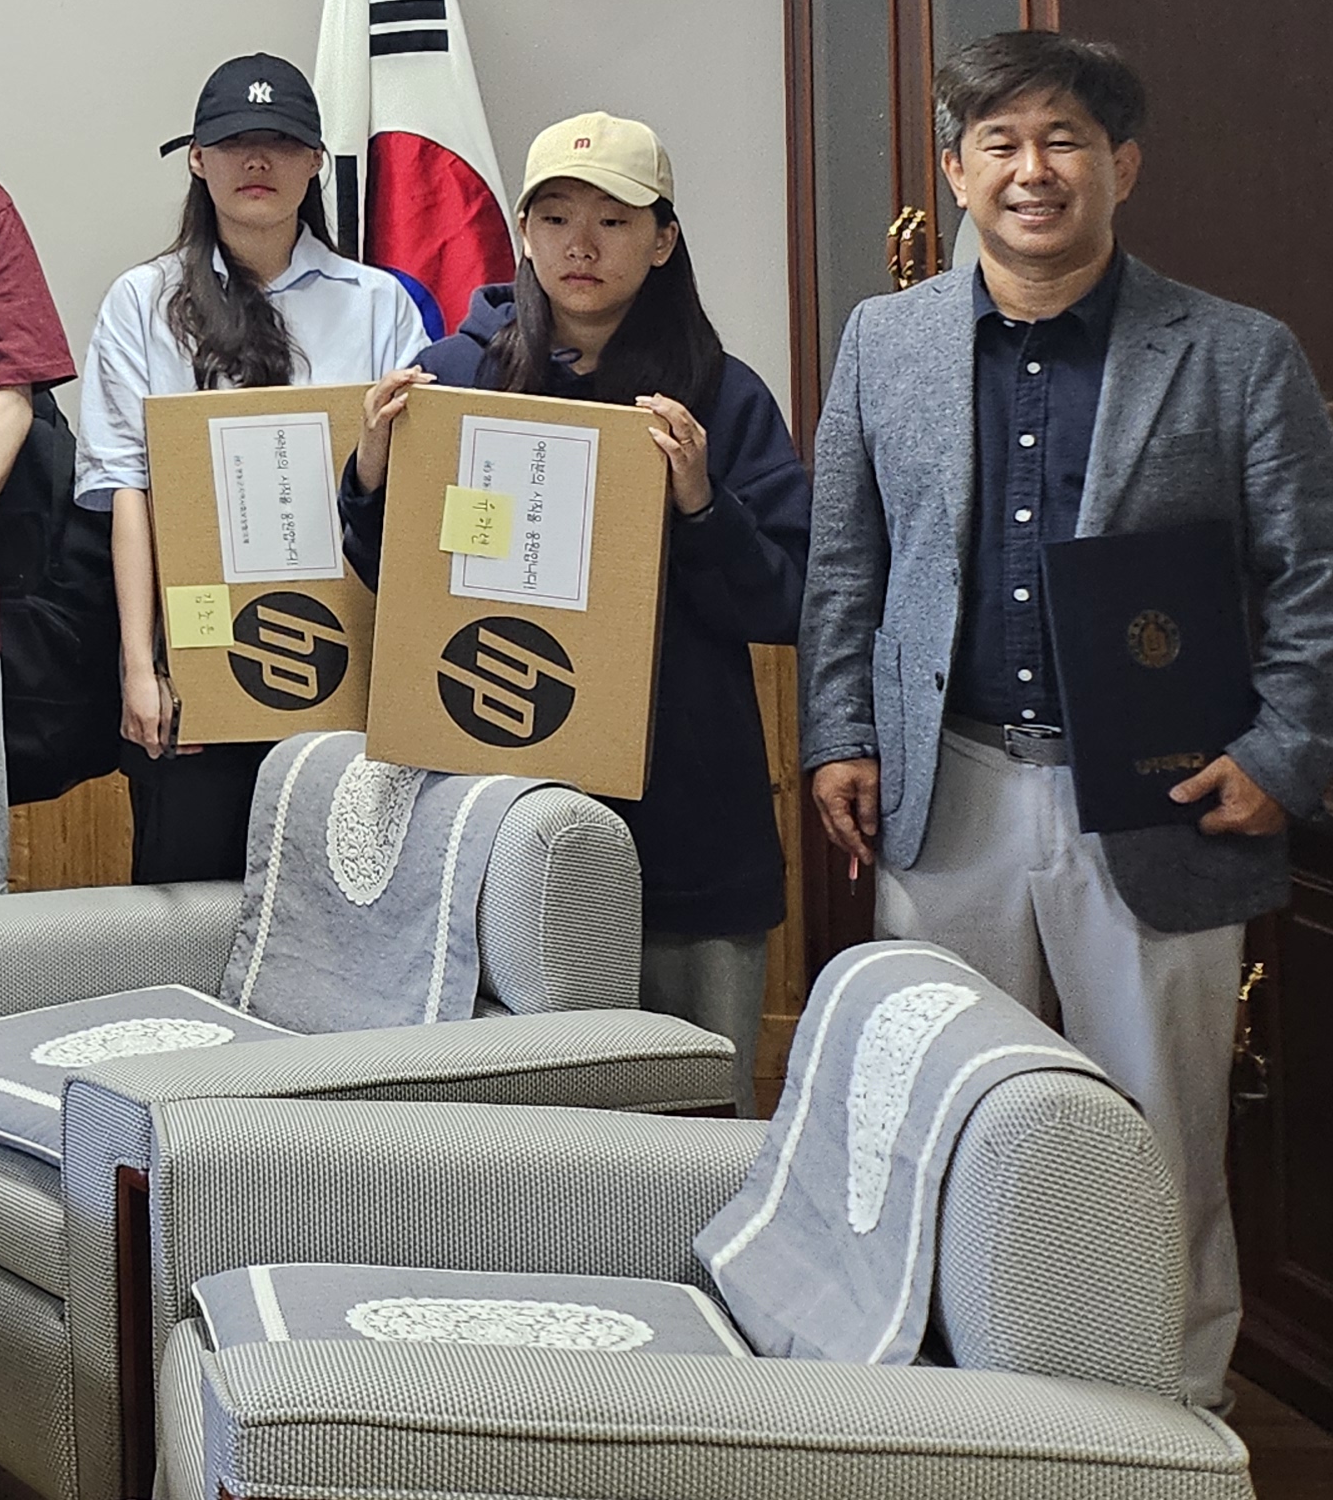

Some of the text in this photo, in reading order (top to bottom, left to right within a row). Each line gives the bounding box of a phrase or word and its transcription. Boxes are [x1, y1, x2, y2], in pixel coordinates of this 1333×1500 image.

[247, 81, 274, 103] NY
[530, 440, 547, 485] 여러분의
[527, 491, 543, 522] 시작을
[228, 604, 349, 700] hp
[438, 620, 576, 739] hp
